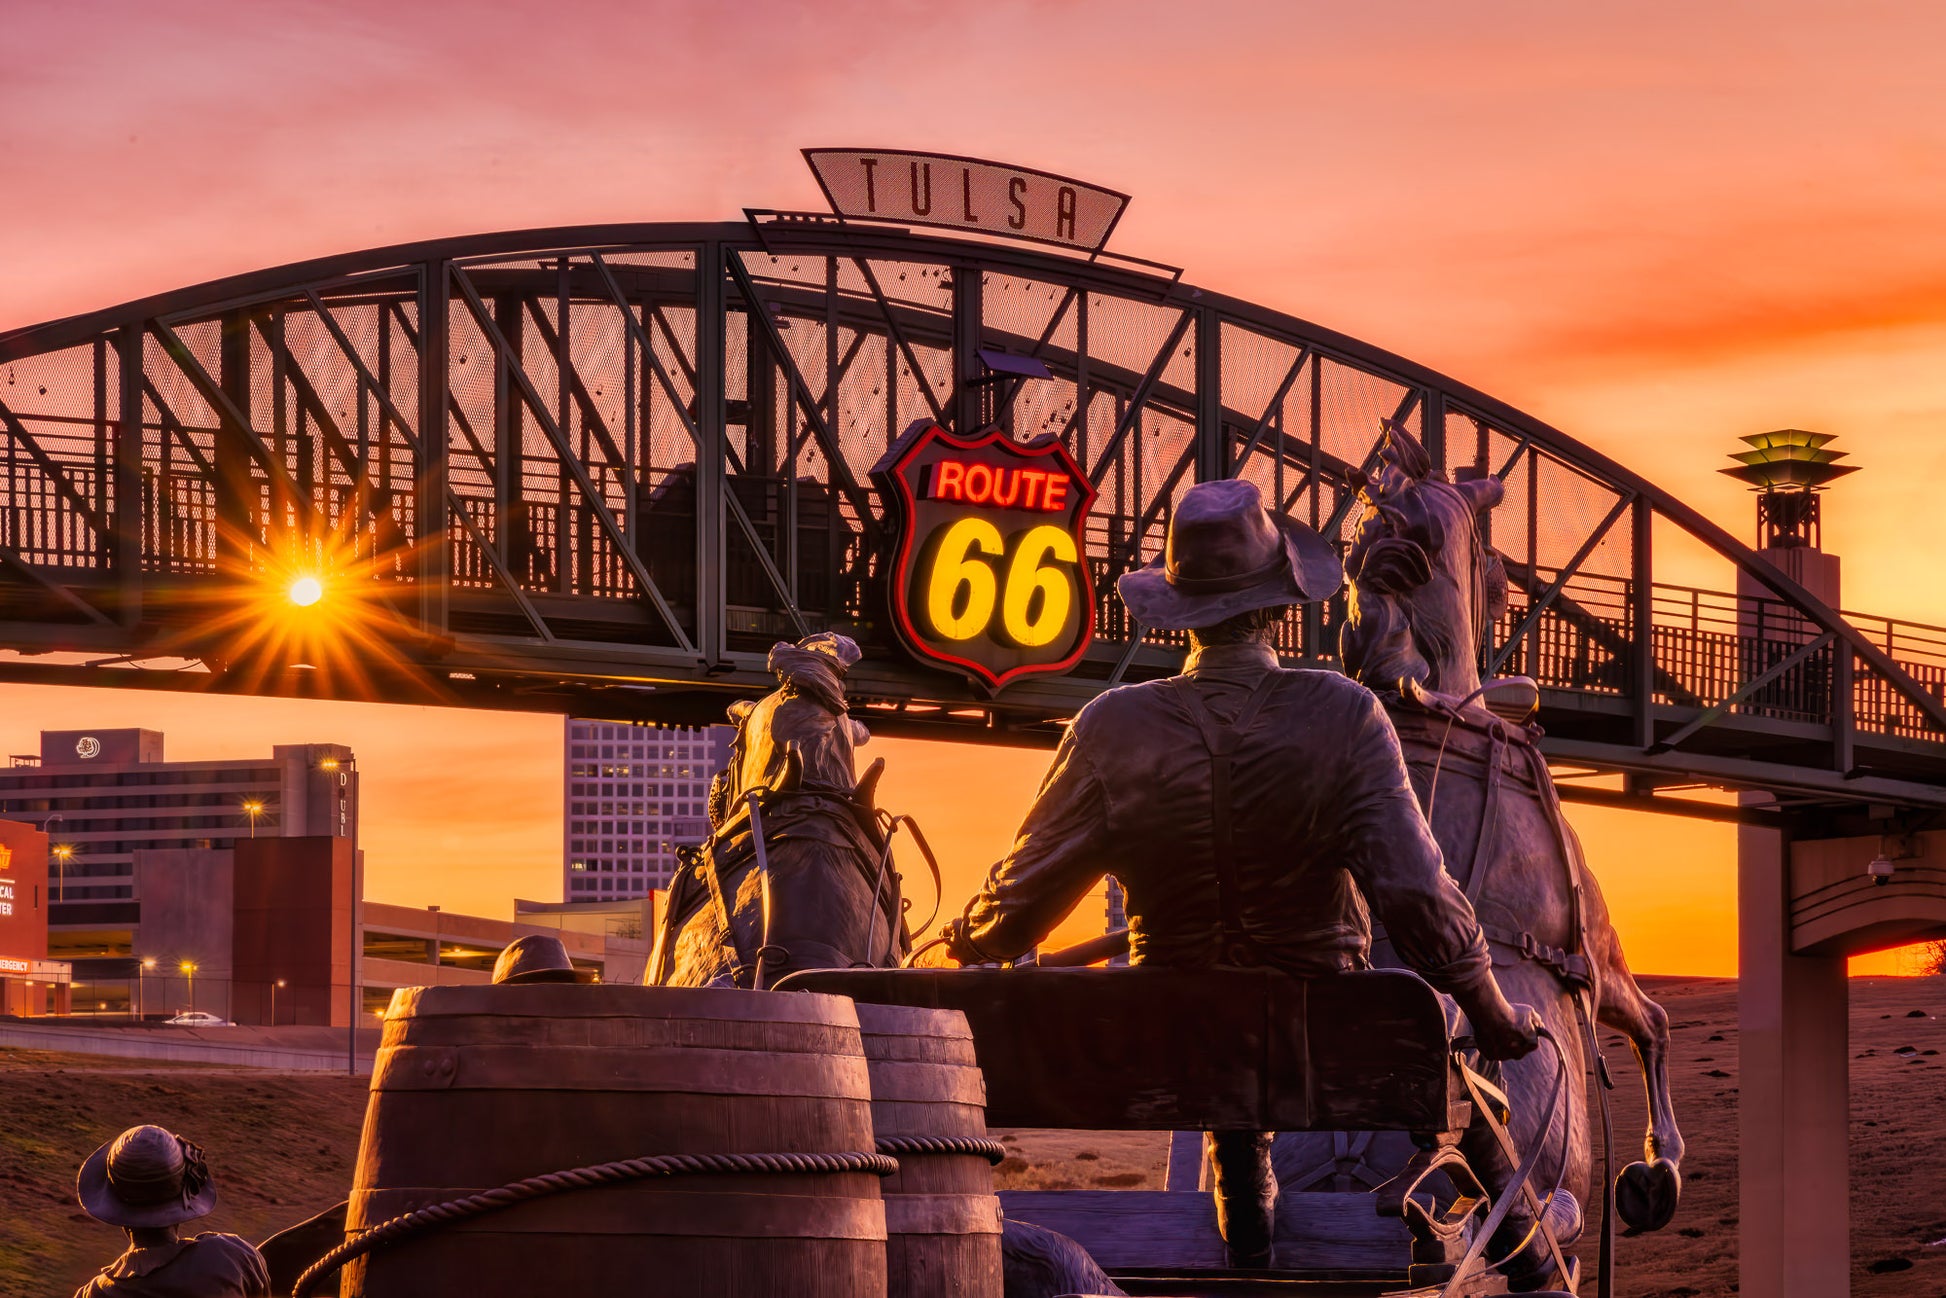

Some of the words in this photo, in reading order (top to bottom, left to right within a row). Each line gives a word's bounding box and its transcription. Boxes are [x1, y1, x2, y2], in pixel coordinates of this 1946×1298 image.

[860, 158, 1077, 240] TULSA
[936, 461, 1070, 511] ROUTE
[928, 517, 1078, 647] 66
